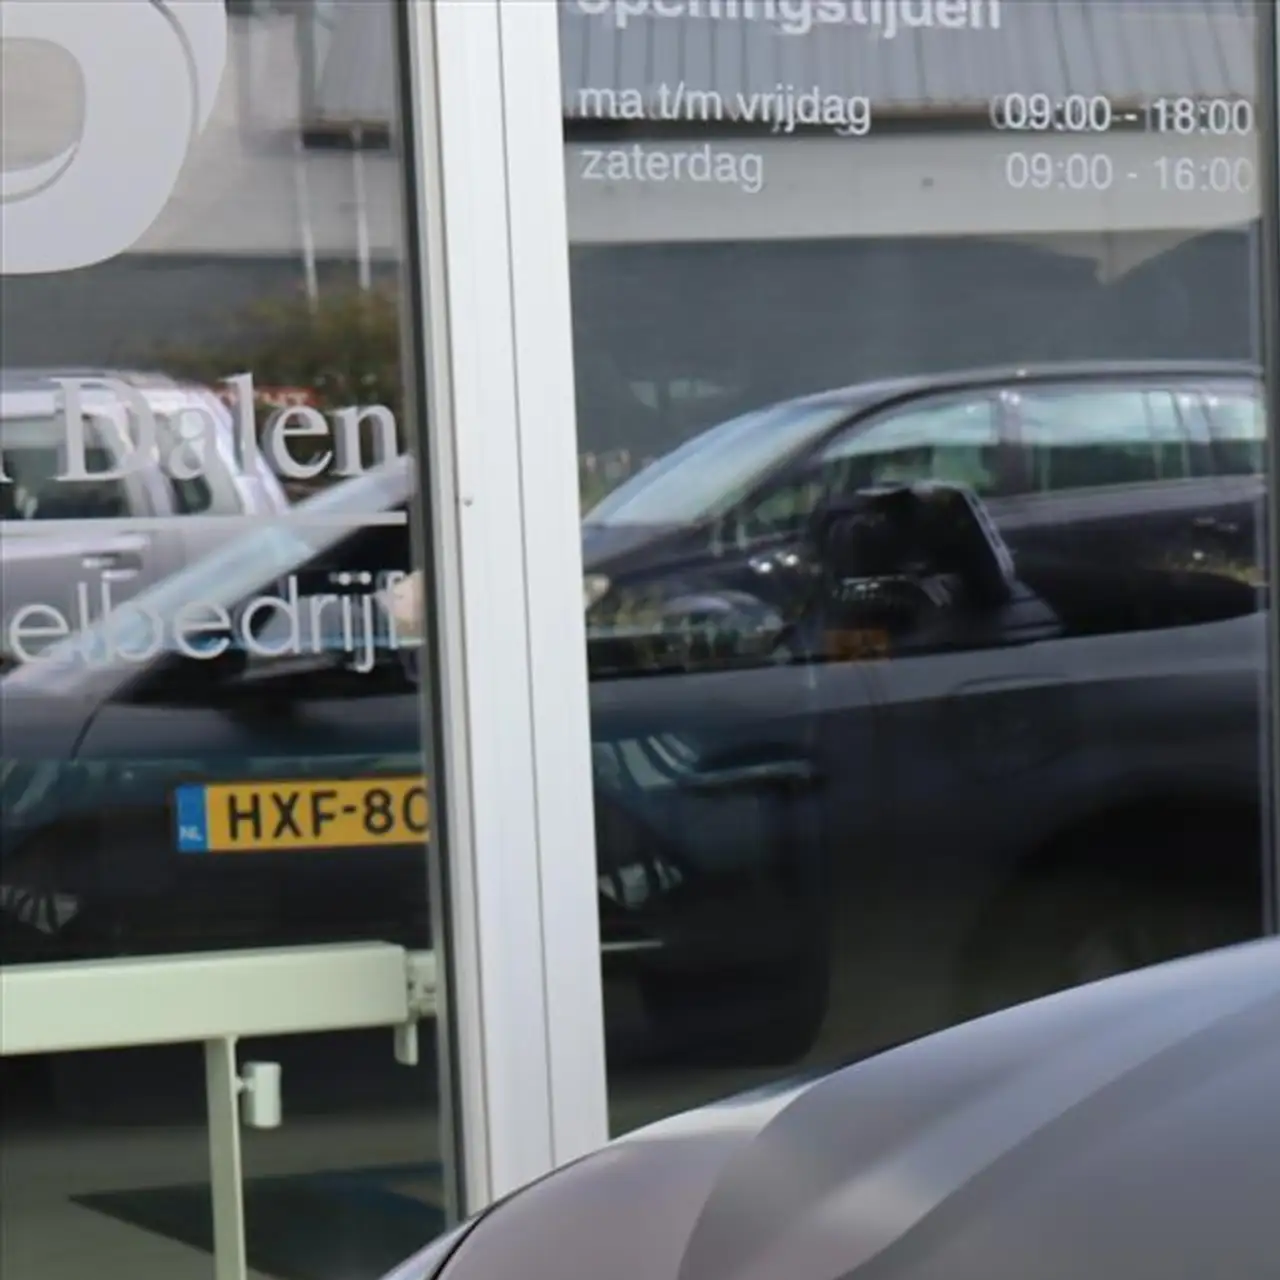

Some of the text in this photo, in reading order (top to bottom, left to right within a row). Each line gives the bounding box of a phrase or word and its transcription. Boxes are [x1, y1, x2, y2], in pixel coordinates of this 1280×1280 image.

[578, 86, 645, 120] ma
[658, 81, 723, 121] t/m
[736, 83, 872, 135] vrijdag
[1003, 93, 1113, 132] 09:00
[1152, 97, 1253, 135] 18:00
[580, 144, 764, 193] zaterdag
[1006, 152, 1114, 190] 09:00
[1153, 156, 1255, 193] 16:00
[50, 371, 402, 482] Dalen
